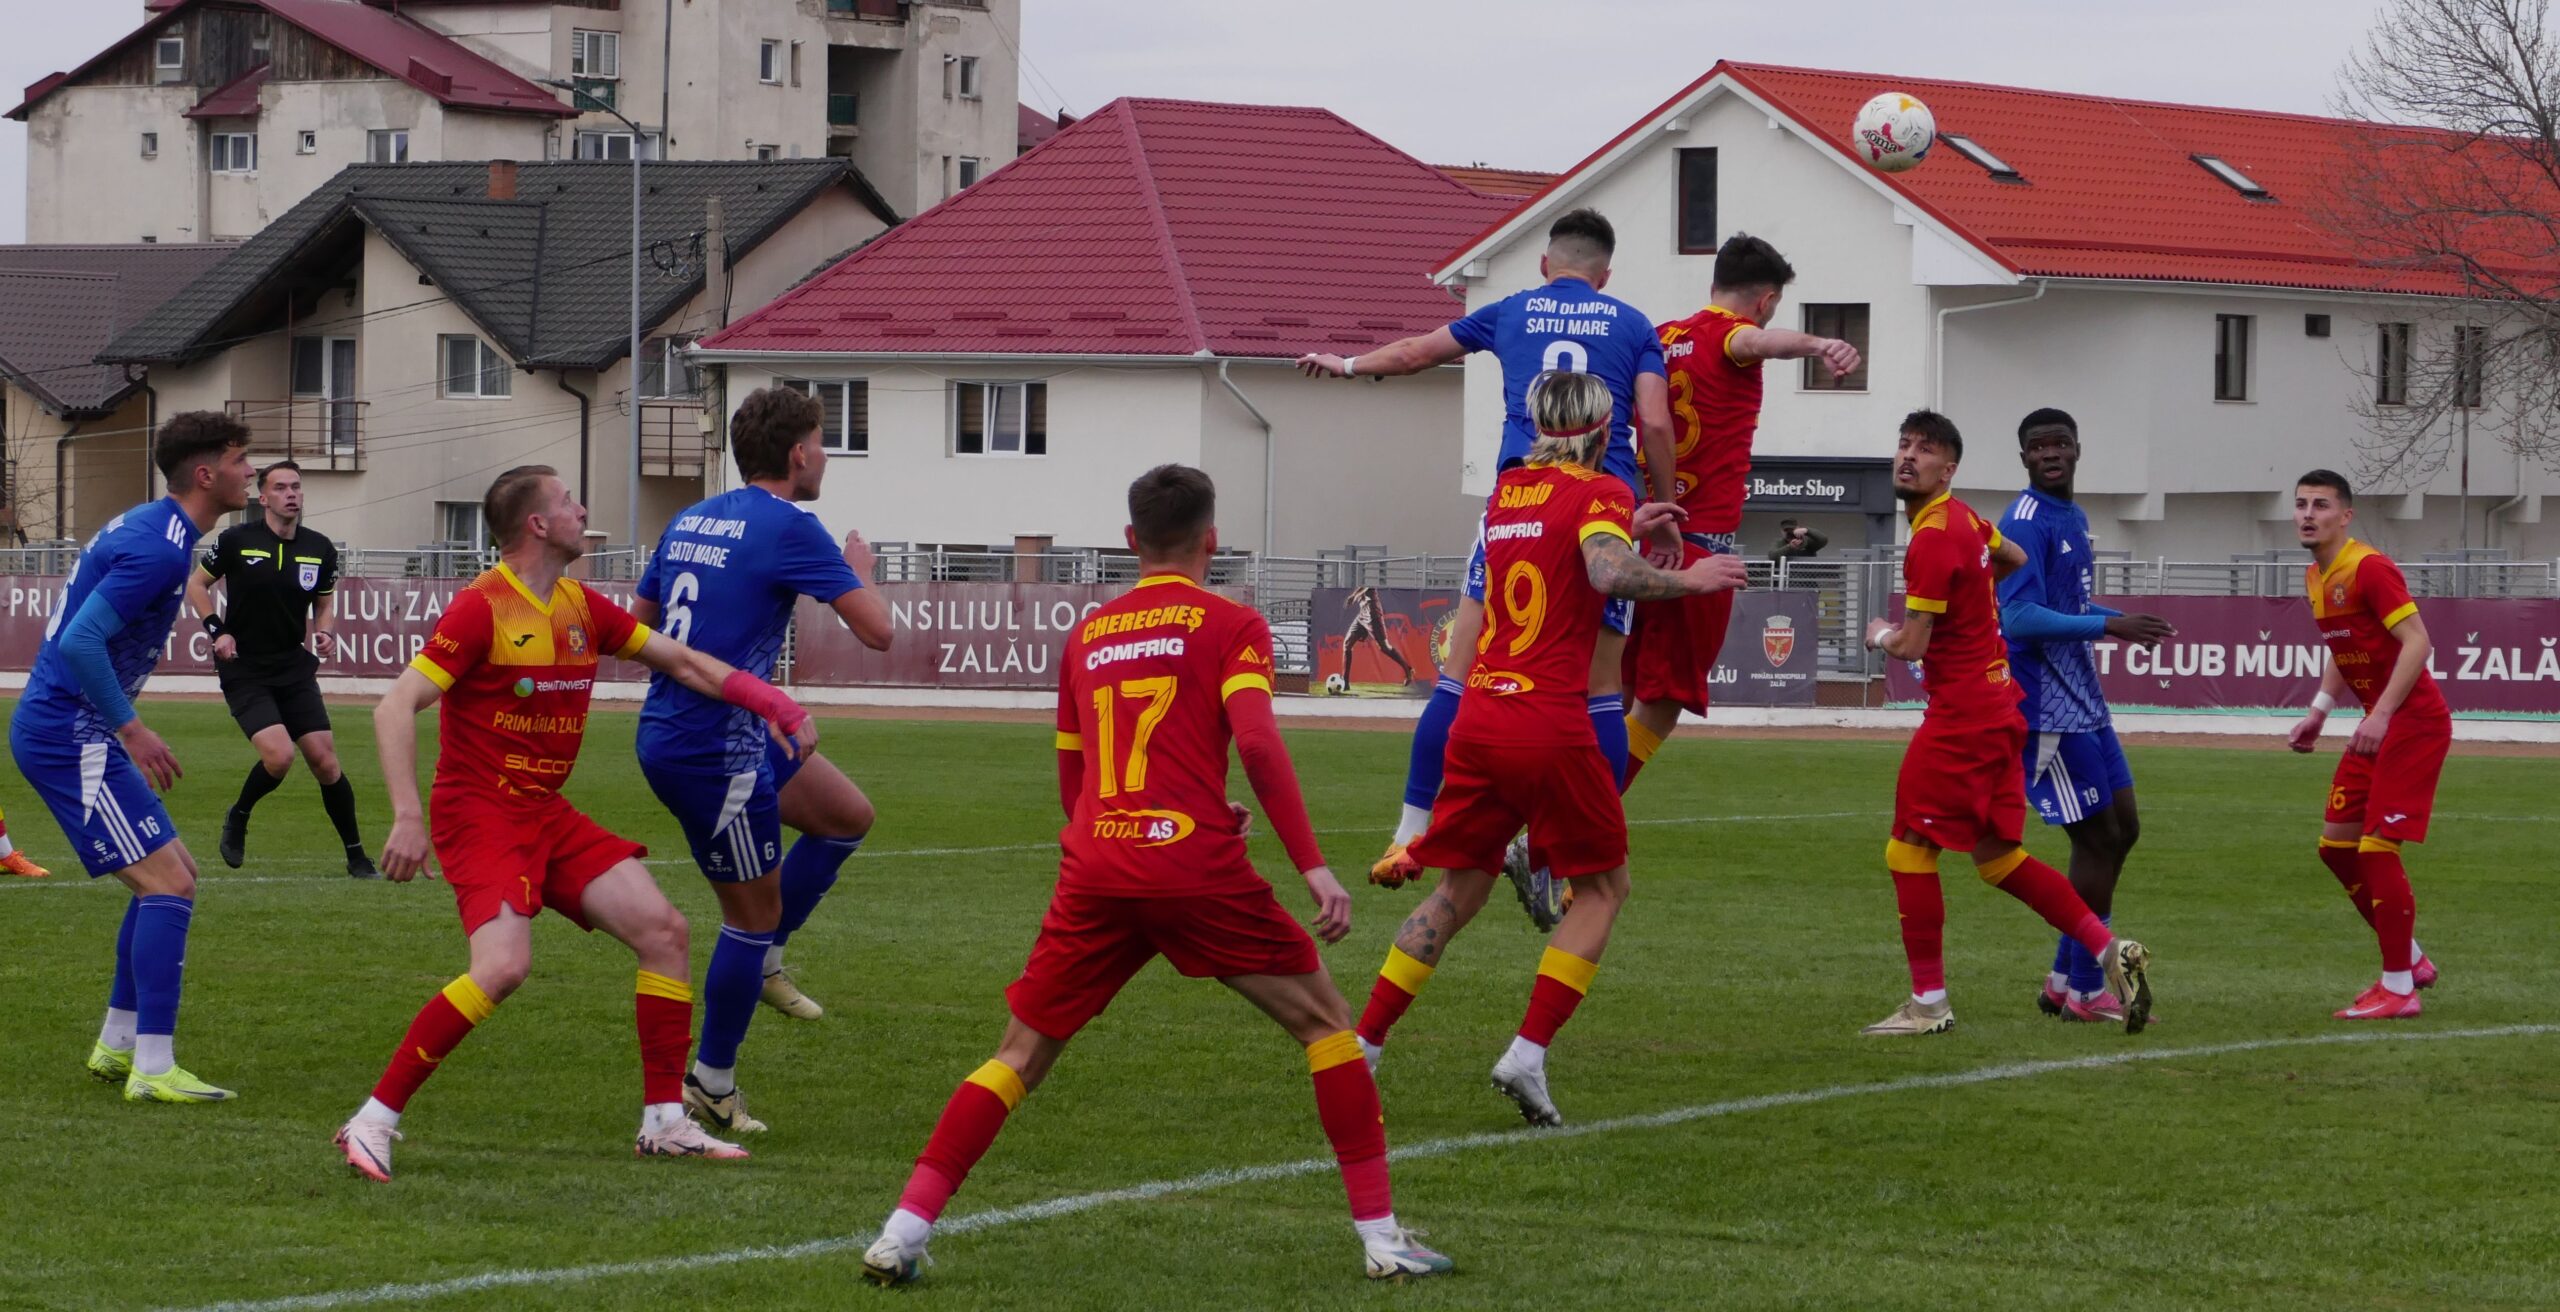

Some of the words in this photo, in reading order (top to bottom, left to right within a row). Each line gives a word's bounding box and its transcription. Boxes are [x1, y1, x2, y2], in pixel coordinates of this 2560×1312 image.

[1526, 297, 1557, 314] CSM
[1560, 303, 1618, 318] OLIMPIA
[1526, 318, 1563, 333] SATU
[1567, 320, 1611, 336] MARE
[1753, 478, 1803, 496] Barber
[1806, 479, 1845, 502] Shop
[698, 517, 747, 540] OLIMPIA
[1487, 521, 1543, 542] COMFRIG
[667, 541, 696, 562] SATU
[692, 543, 730, 569] MARE
[662, 572, 699, 646] 6
[432, 630, 460, 653] Avril
[938, 635, 1048, 674] ZALĂU
[1086, 638, 1185, 671] COMFRIG
[2126, 643, 2226, 676] CLUB
[1093, 675, 1178, 799] 17
[505, 753, 574, 774] SILCO
[2082, 786, 2099, 807] 19
[137, 815, 161, 839] 16
[1093, 820, 1144, 839] TOTAL
[1147, 820, 1174, 839] AS
[764, 841, 775, 861] 6
